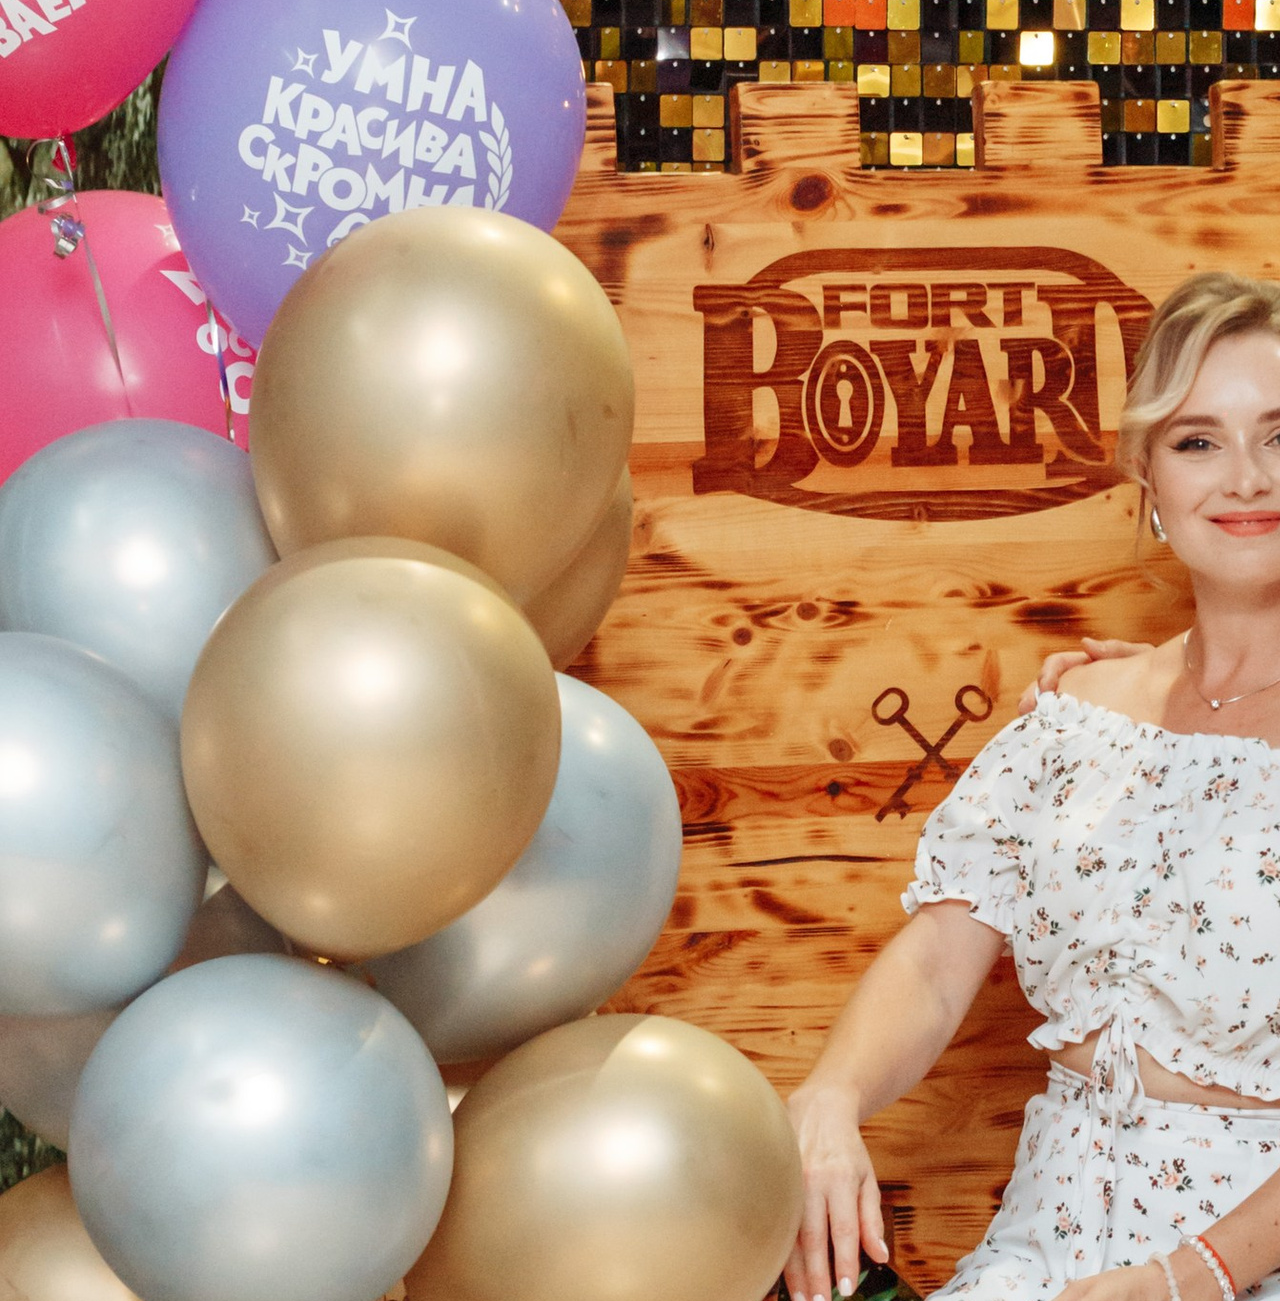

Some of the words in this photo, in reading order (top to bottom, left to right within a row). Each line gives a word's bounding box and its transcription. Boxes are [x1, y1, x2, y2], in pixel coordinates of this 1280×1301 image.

[320, 29, 488, 122] УМНА
[262, 75, 477, 179] КРАСИВА
[822, 282, 1039, 330] FORT
